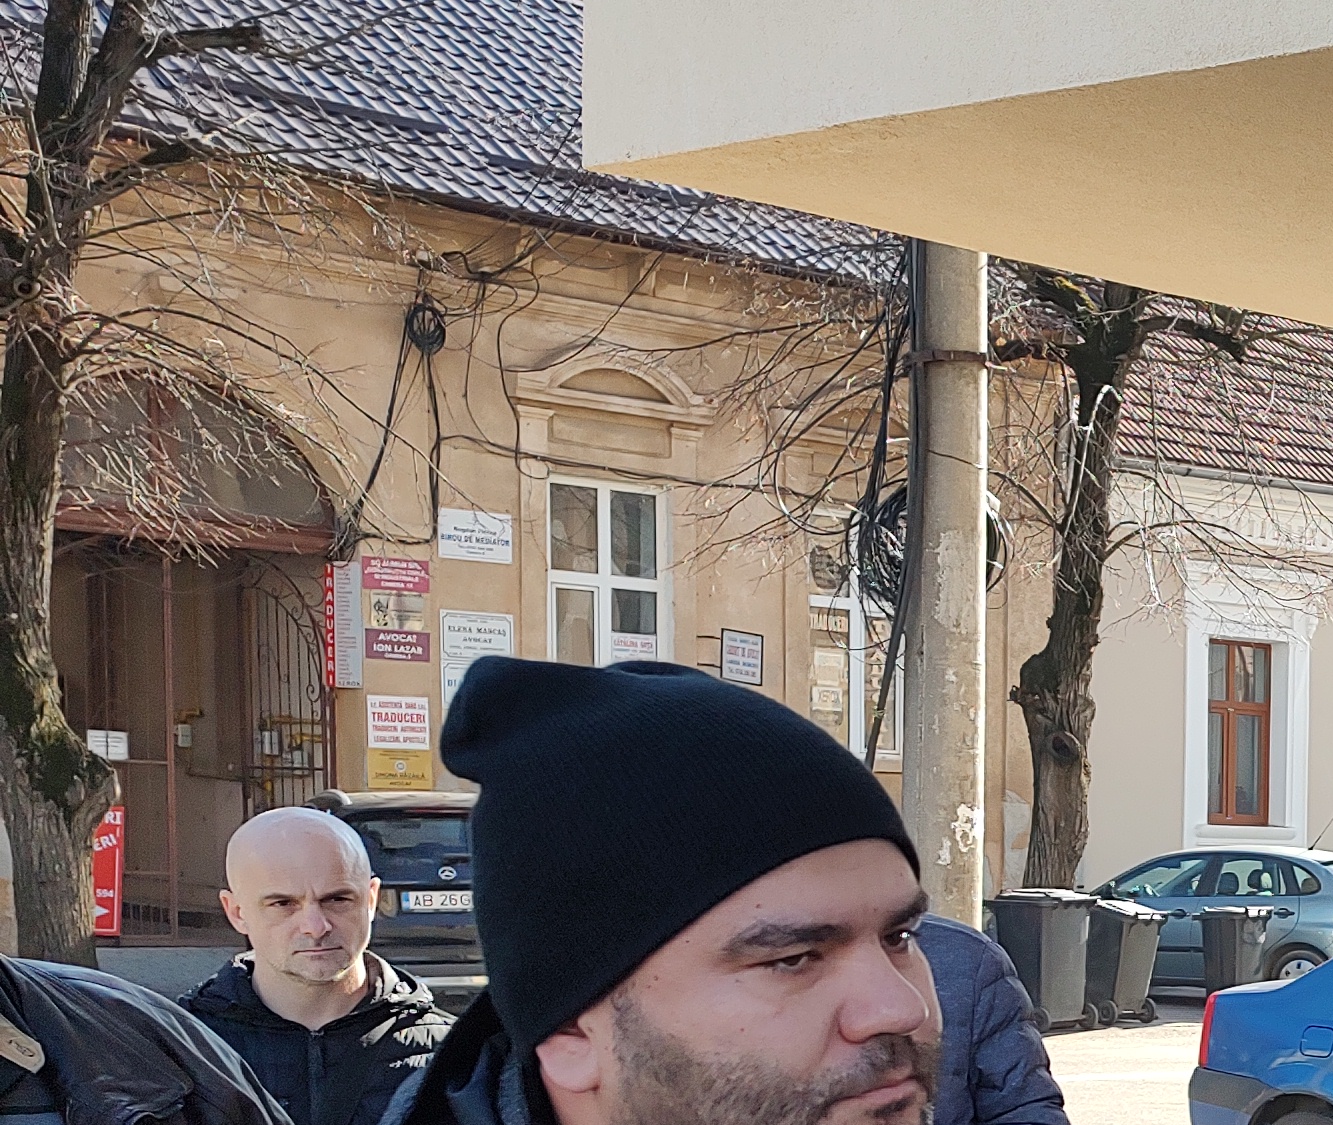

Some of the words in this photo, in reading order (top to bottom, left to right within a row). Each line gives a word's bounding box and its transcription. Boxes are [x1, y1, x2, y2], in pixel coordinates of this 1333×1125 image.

[326, 563, 335, 684] TRADUCERI
[378, 632, 417, 644] AVOCAT
[373, 642, 392, 653] ION
[371, 711, 426, 723] TRADUCERI
[414, 894, 434, 907] AB
